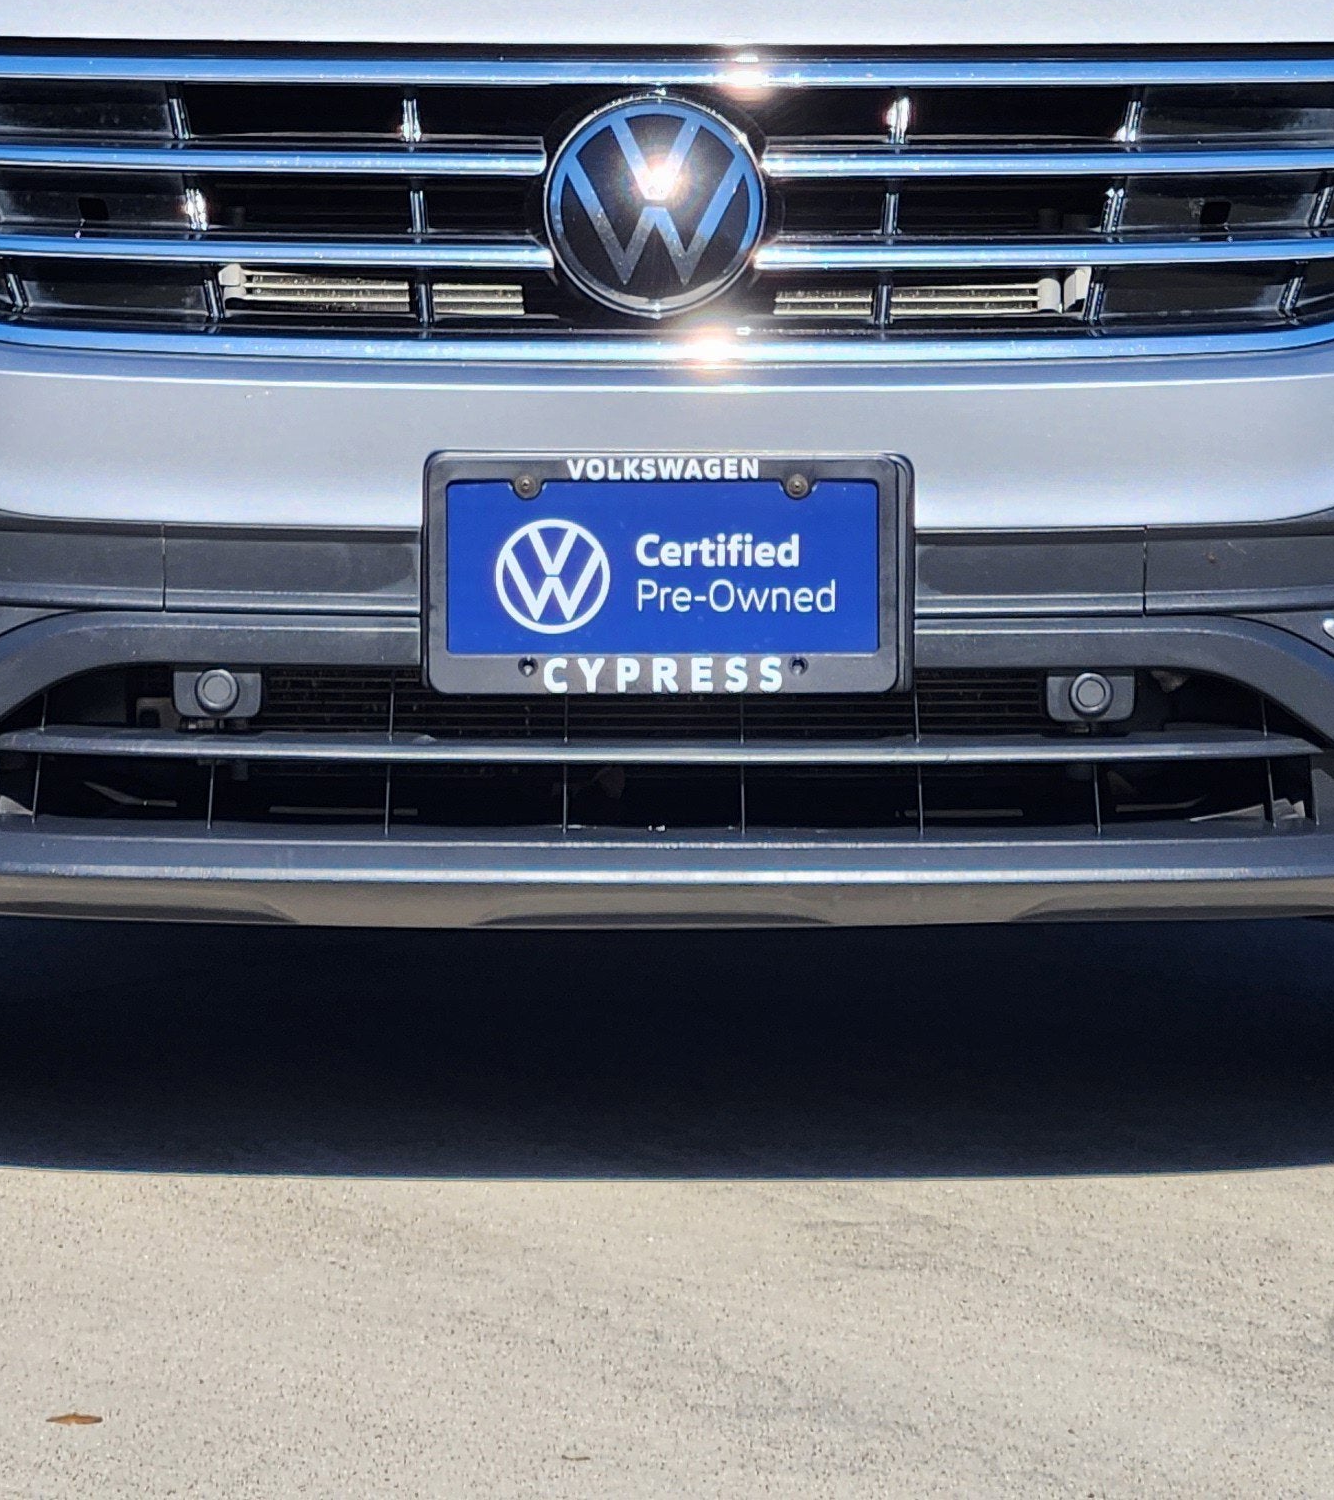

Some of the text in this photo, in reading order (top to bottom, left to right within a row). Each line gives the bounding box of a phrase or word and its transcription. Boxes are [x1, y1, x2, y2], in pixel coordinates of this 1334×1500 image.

[567, 458, 759, 481] VOLKSWAGEN
[636, 534, 799, 567] Certified
[495, 519, 611, 634] VW
[637, 578, 836, 612] Pre-Owned
[544, 657, 782, 693] CYPRESS
